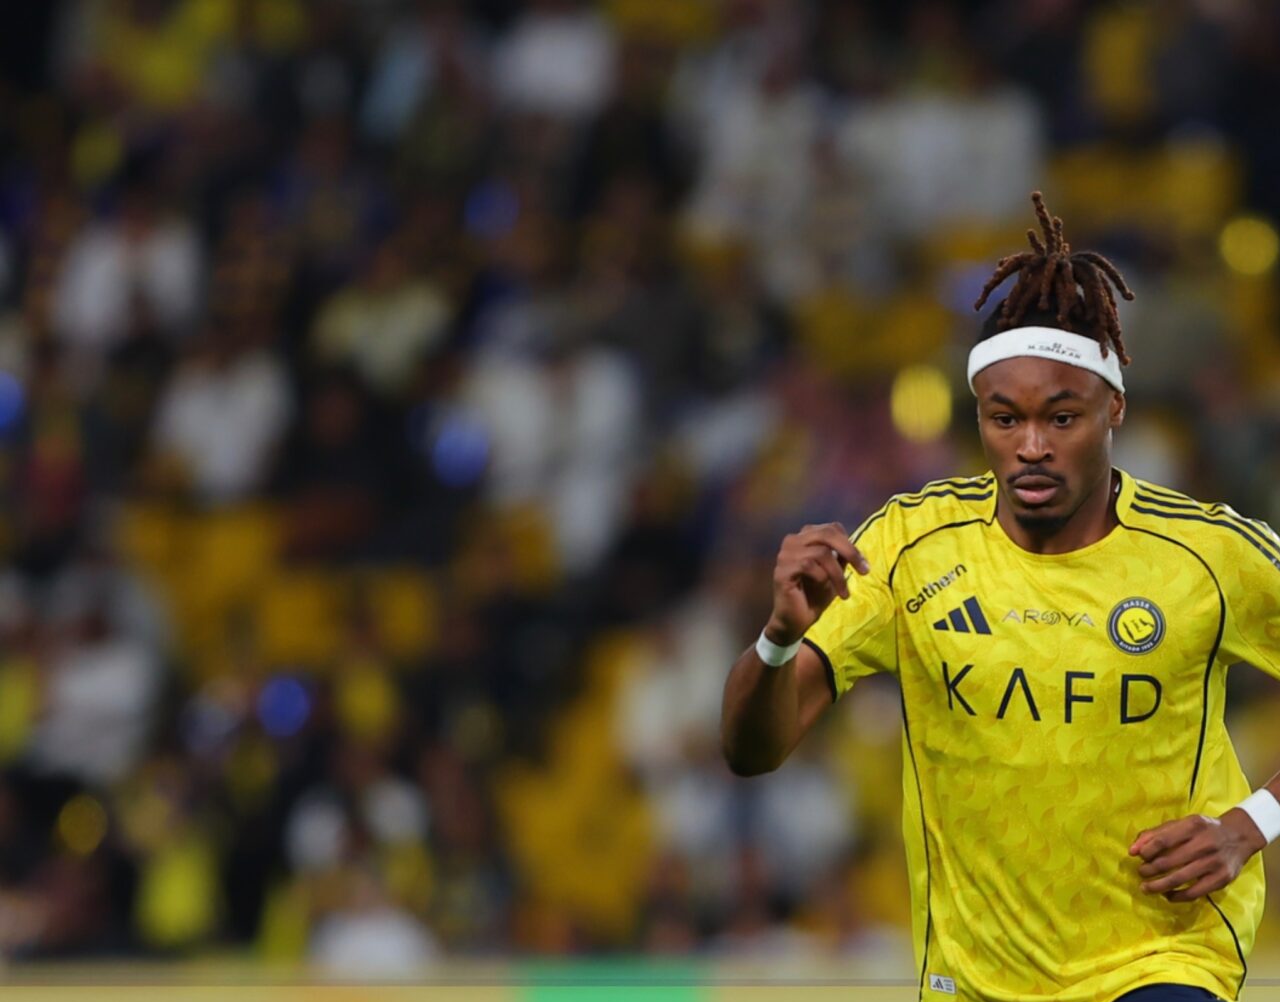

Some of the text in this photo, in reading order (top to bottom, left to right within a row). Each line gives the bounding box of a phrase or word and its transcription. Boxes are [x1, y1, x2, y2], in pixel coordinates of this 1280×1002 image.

[906, 564, 967, 614] Gathern
[1002, 609, 1095, 628] AROYA
[941, 661, 1162, 724] KAFD
